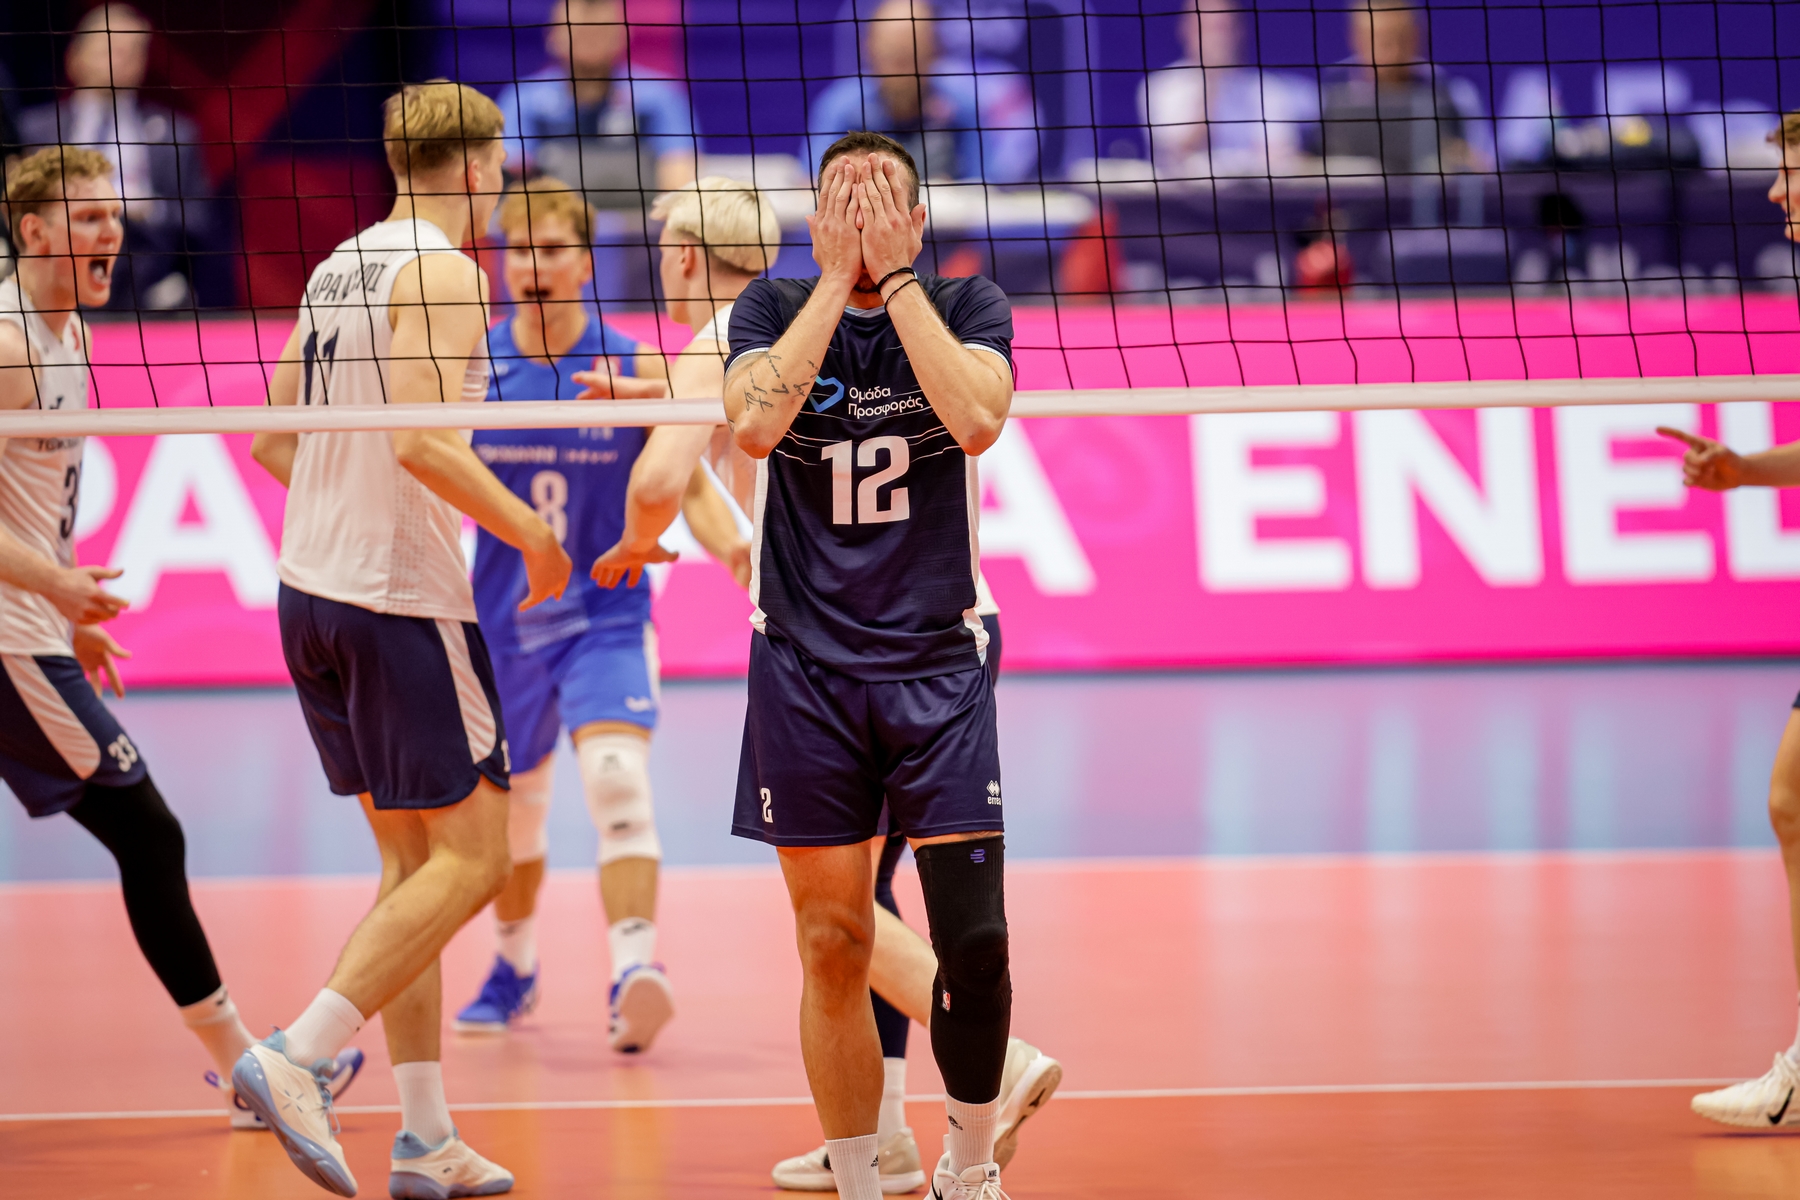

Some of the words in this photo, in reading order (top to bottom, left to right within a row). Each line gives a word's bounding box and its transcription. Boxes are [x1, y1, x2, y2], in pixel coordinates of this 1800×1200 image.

[848, 396, 924, 419] Προσφοράς
[849, 386, 891, 403] Ομάδα
[821, 435, 910, 525] 12
[60, 459, 83, 540] 3
[531, 469, 568, 548] 8
[107, 733, 138, 773] 33
[501, 739, 511, 772] 1
[760, 787, 774, 823] 2
